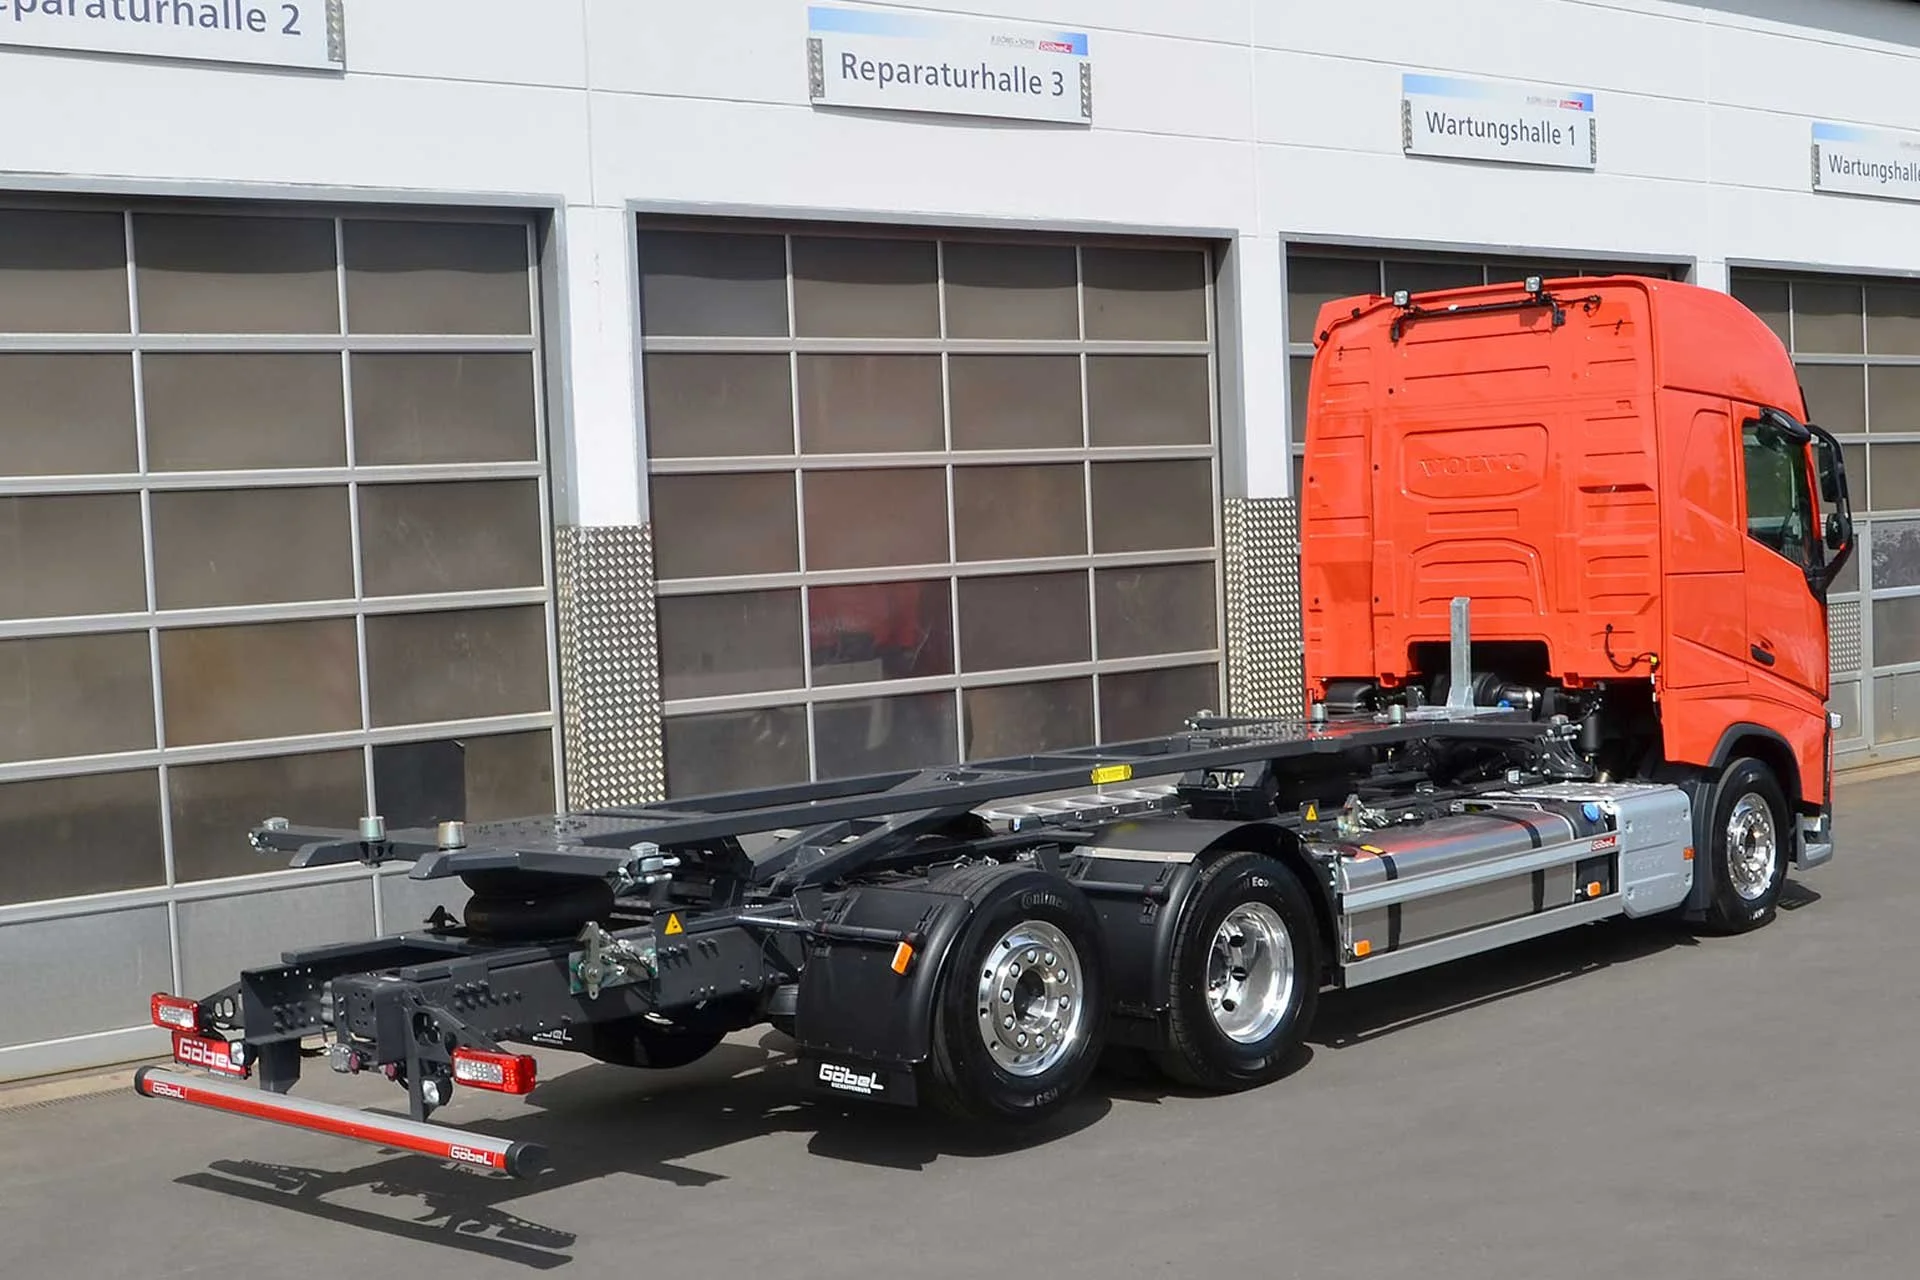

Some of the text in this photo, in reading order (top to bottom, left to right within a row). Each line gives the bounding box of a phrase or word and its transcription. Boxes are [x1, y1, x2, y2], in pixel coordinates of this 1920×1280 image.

[281, 4, 302, 36] 2
[841, 51, 1065, 97] Reparaturhalle 3
[1425, 110, 1576, 146] Wartungshalle 1
[1828, 153, 1920, 184] Wartungshall
[1418, 452, 1529, 478] VOLVO
